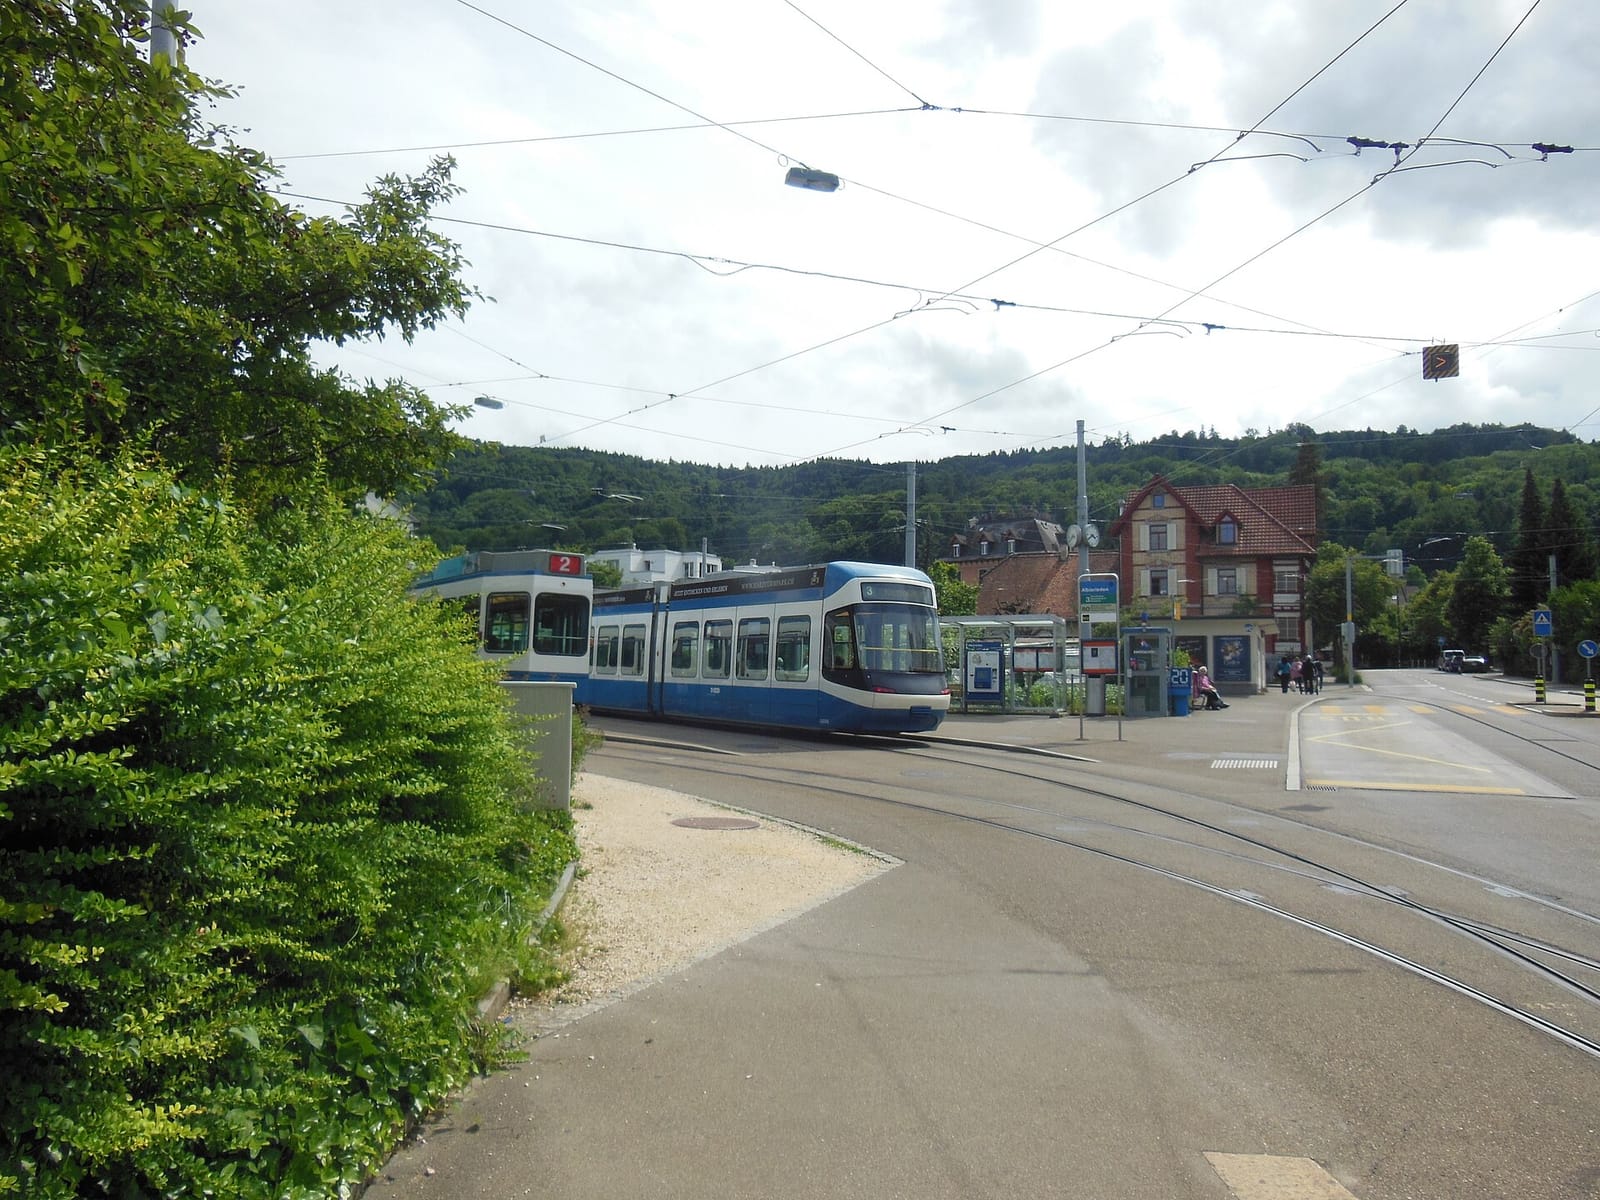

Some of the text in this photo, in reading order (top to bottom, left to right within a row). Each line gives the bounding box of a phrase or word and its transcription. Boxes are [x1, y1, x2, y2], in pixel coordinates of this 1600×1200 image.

[559, 556, 570, 572] 2
[866, 586, 873, 596] 3
[1171, 669, 1189, 684] 20
